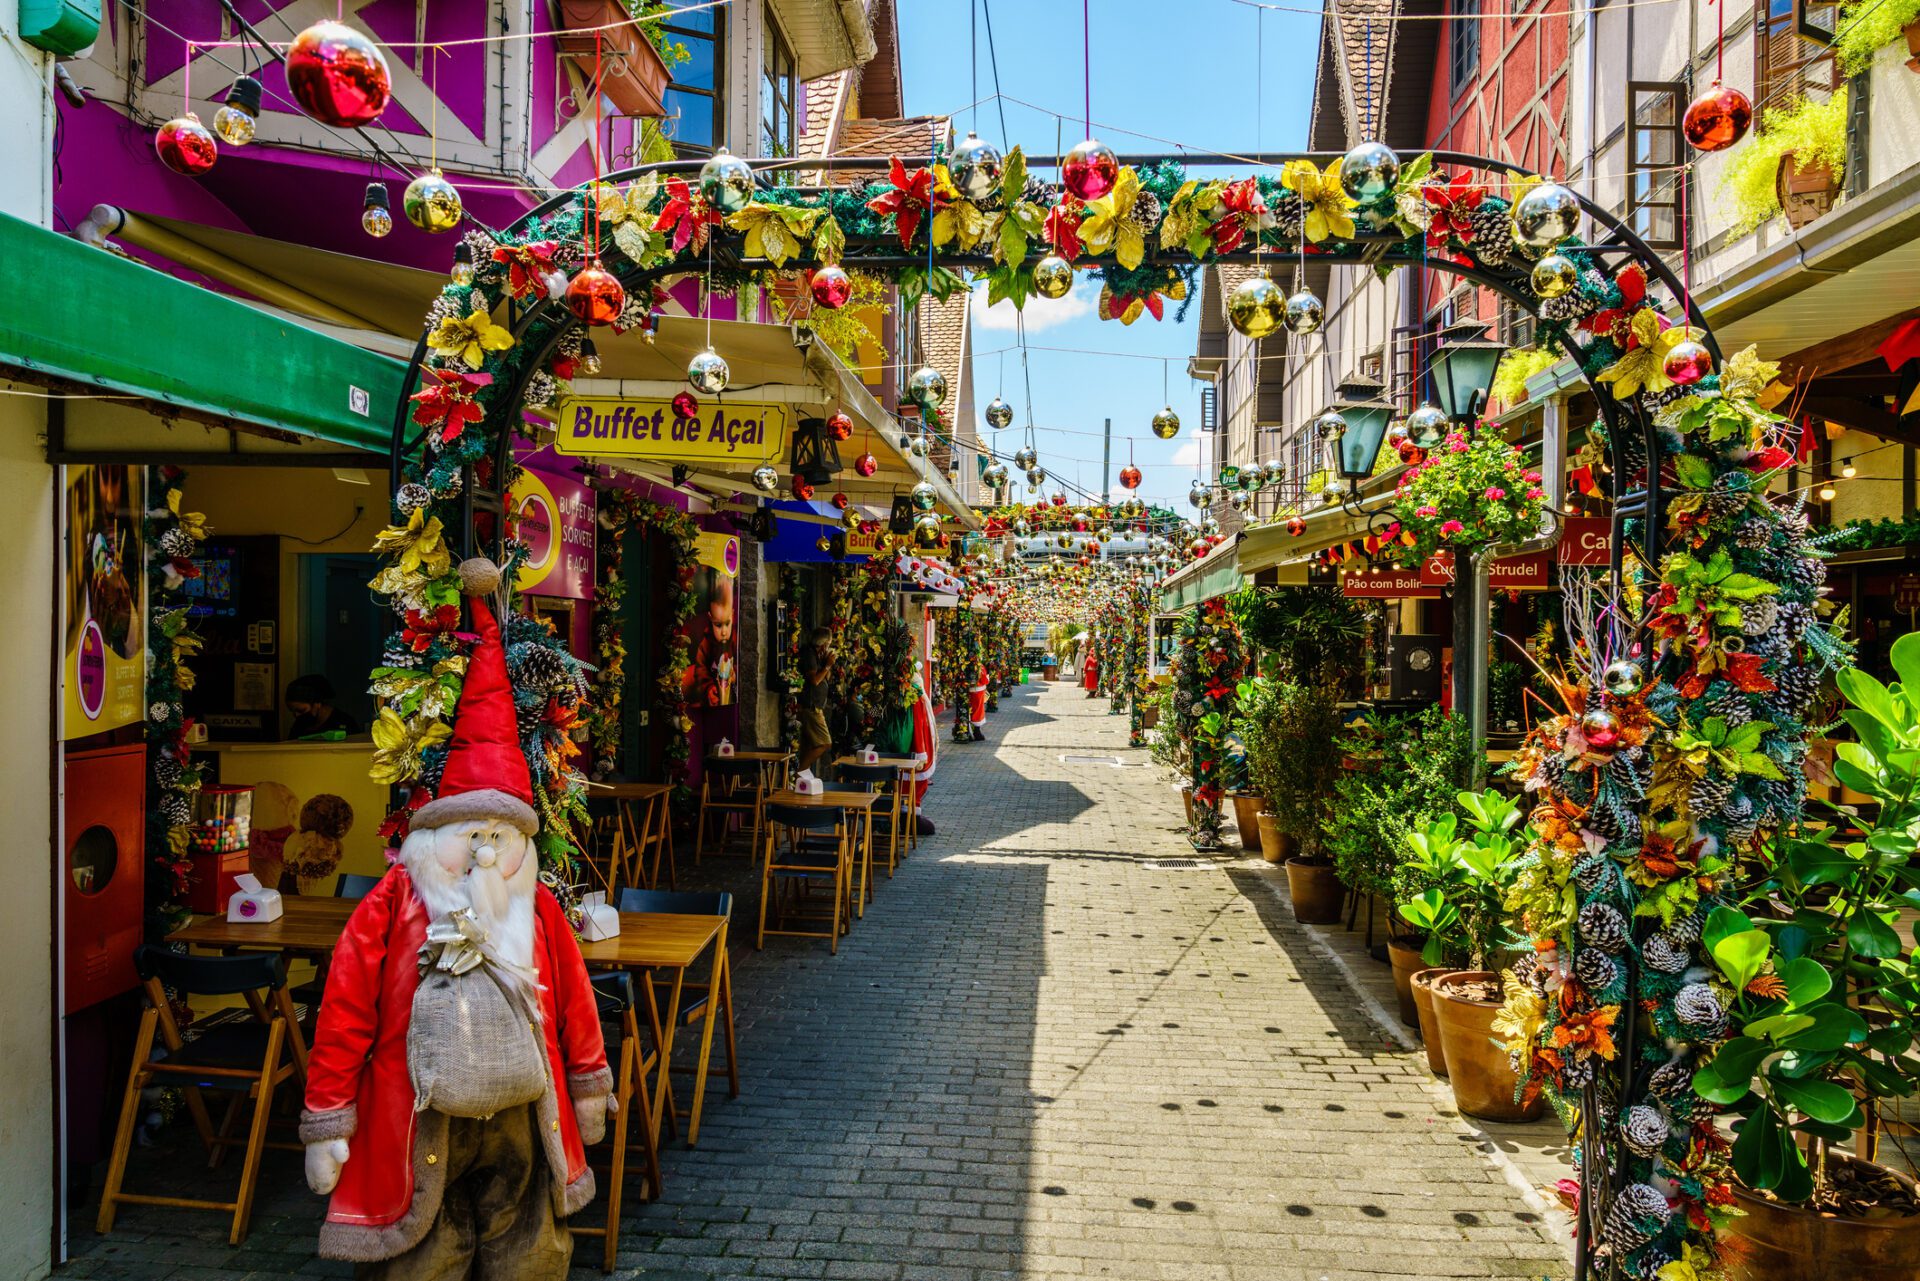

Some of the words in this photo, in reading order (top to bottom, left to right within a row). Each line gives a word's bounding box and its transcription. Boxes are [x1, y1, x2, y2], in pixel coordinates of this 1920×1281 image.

[573, 406, 664, 440] Buffet
[671, 416, 701, 441] de
[707, 410, 767, 452] Açaí
[559, 496, 586, 520] BUFFET
[587, 506, 595, 523] DE
[562, 524, 593, 549] SORVETE
[849, 533, 876, 547] Buff
[1581, 532, 1613, 549] Caf
[567, 553, 573, 570] E
[1429, 562, 1455, 575] Cuc
[1489, 563, 1538, 576] Strudel
[1347, 579, 1368, 589] Pão
[1370, 581, 1392, 589] com
[212, 717, 252, 726] CAIXA
